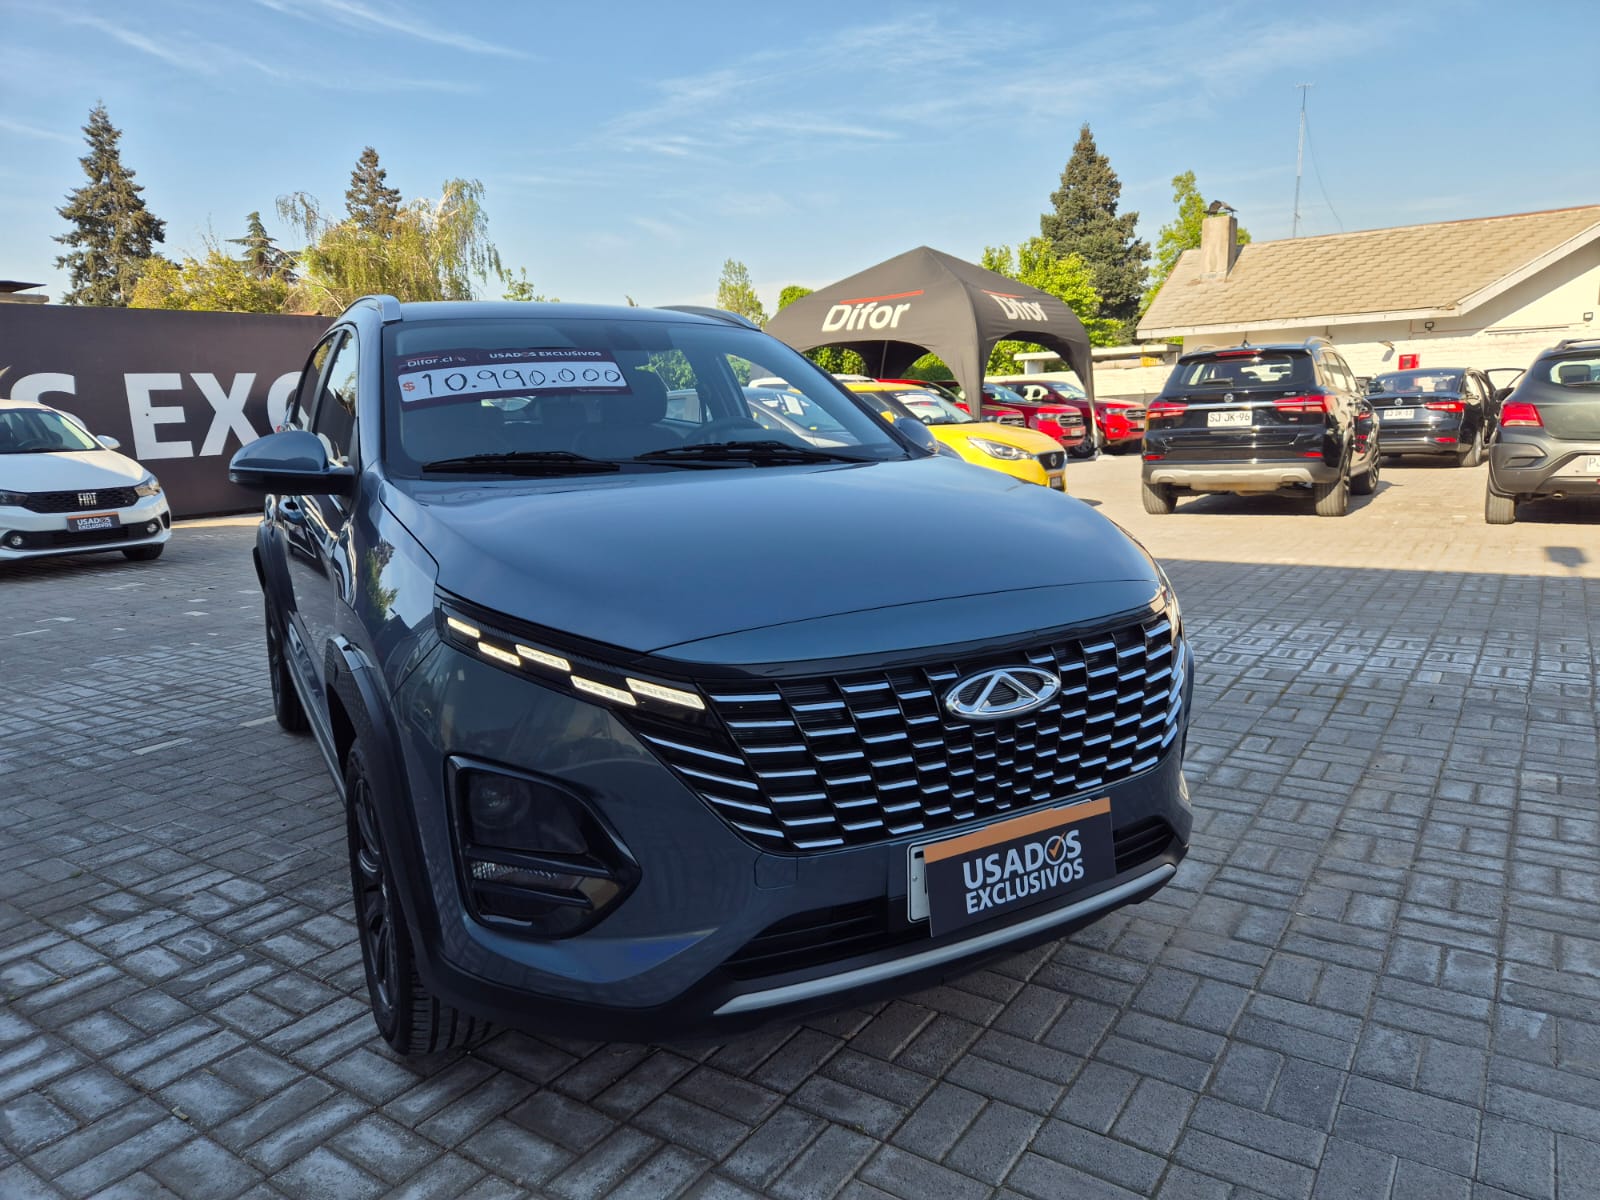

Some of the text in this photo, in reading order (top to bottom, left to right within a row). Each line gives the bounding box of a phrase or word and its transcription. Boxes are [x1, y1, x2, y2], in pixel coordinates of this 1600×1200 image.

[822, 301, 911, 332] Difor
[989, 294, 1049, 321] Difor
[962, 829, 1082, 890] USADOS
[965, 858, 1084, 915] EXCLUSIVOS
